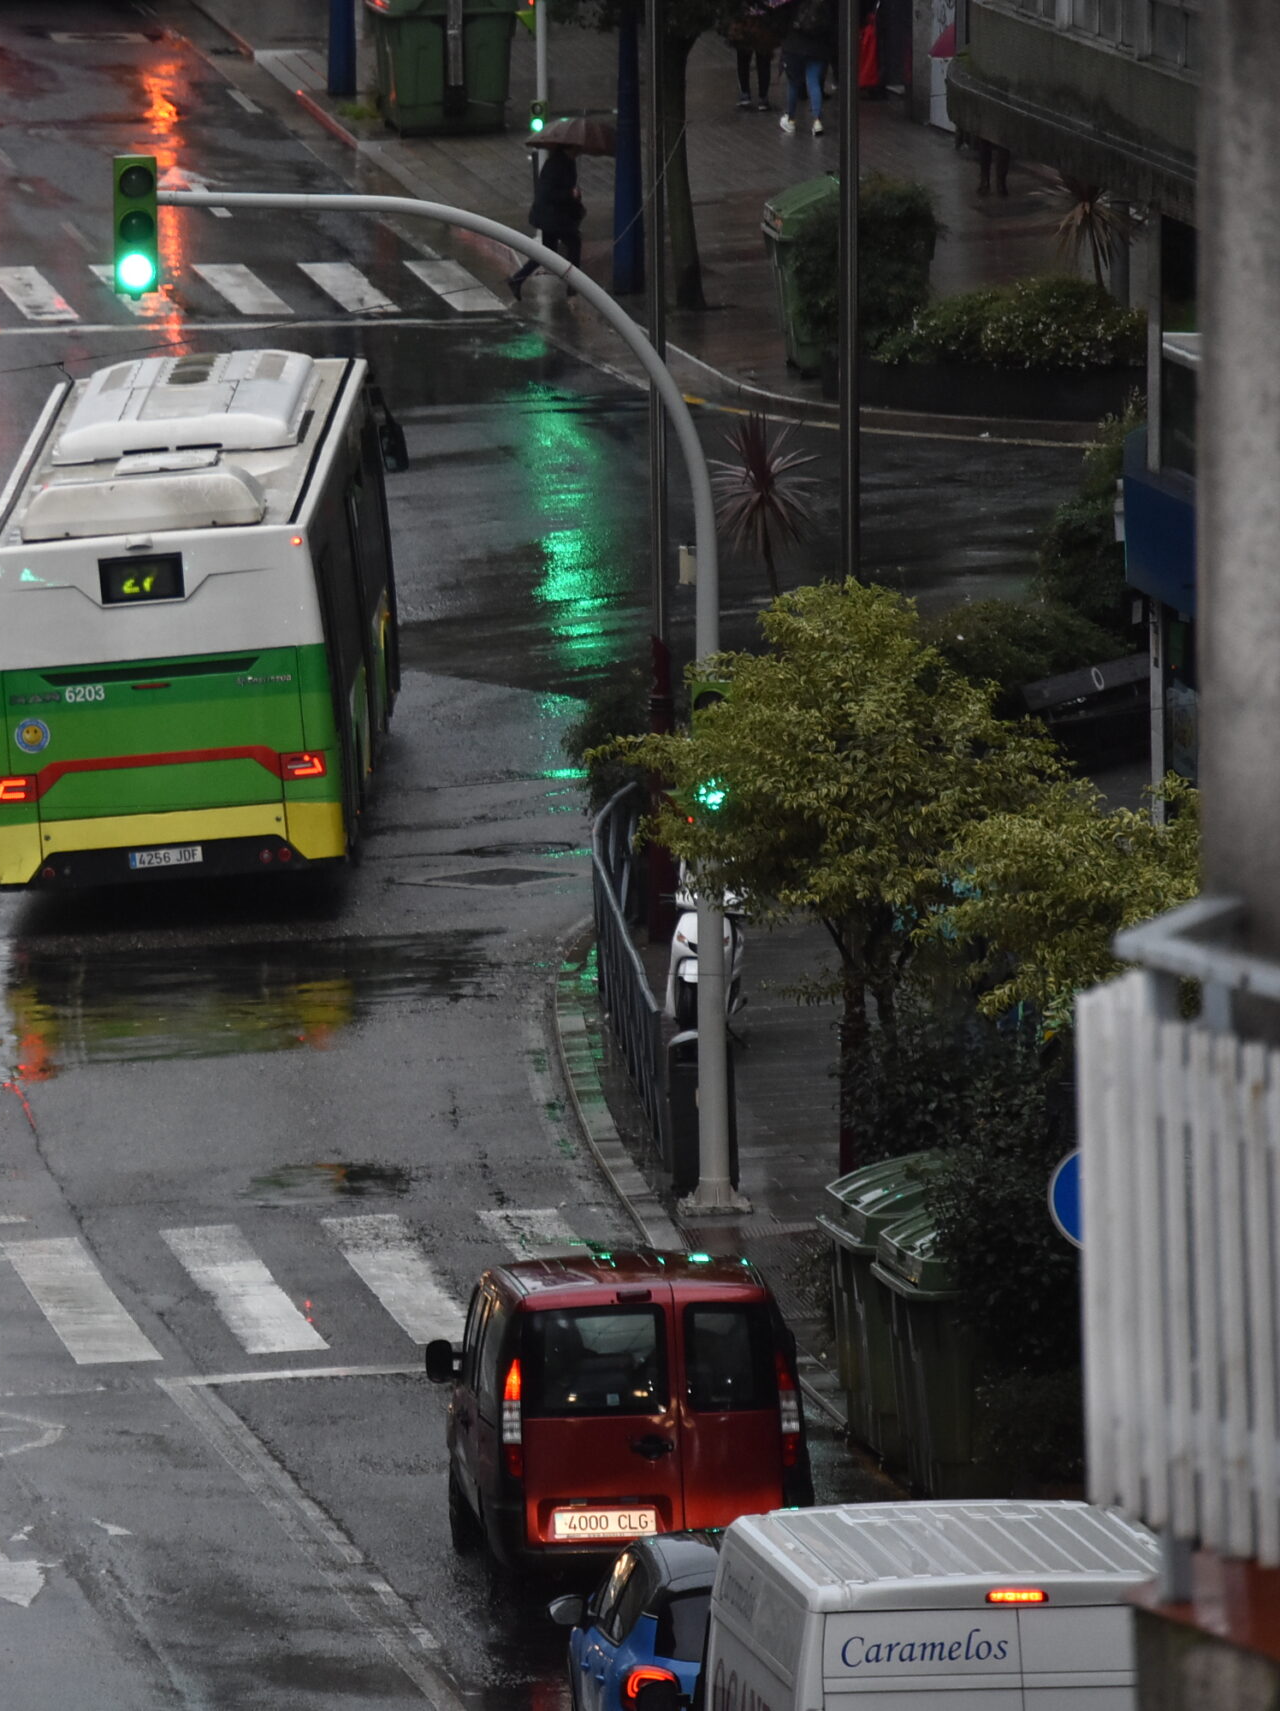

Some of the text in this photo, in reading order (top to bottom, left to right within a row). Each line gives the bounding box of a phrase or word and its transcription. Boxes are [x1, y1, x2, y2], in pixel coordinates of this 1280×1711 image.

[65, 684, 105, 703] 6203
[138, 848, 199, 866] 4256 JDF
[568, 1513, 649, 1531] 4000 CLG
[840, 1628, 1009, 1668] Caramelos
